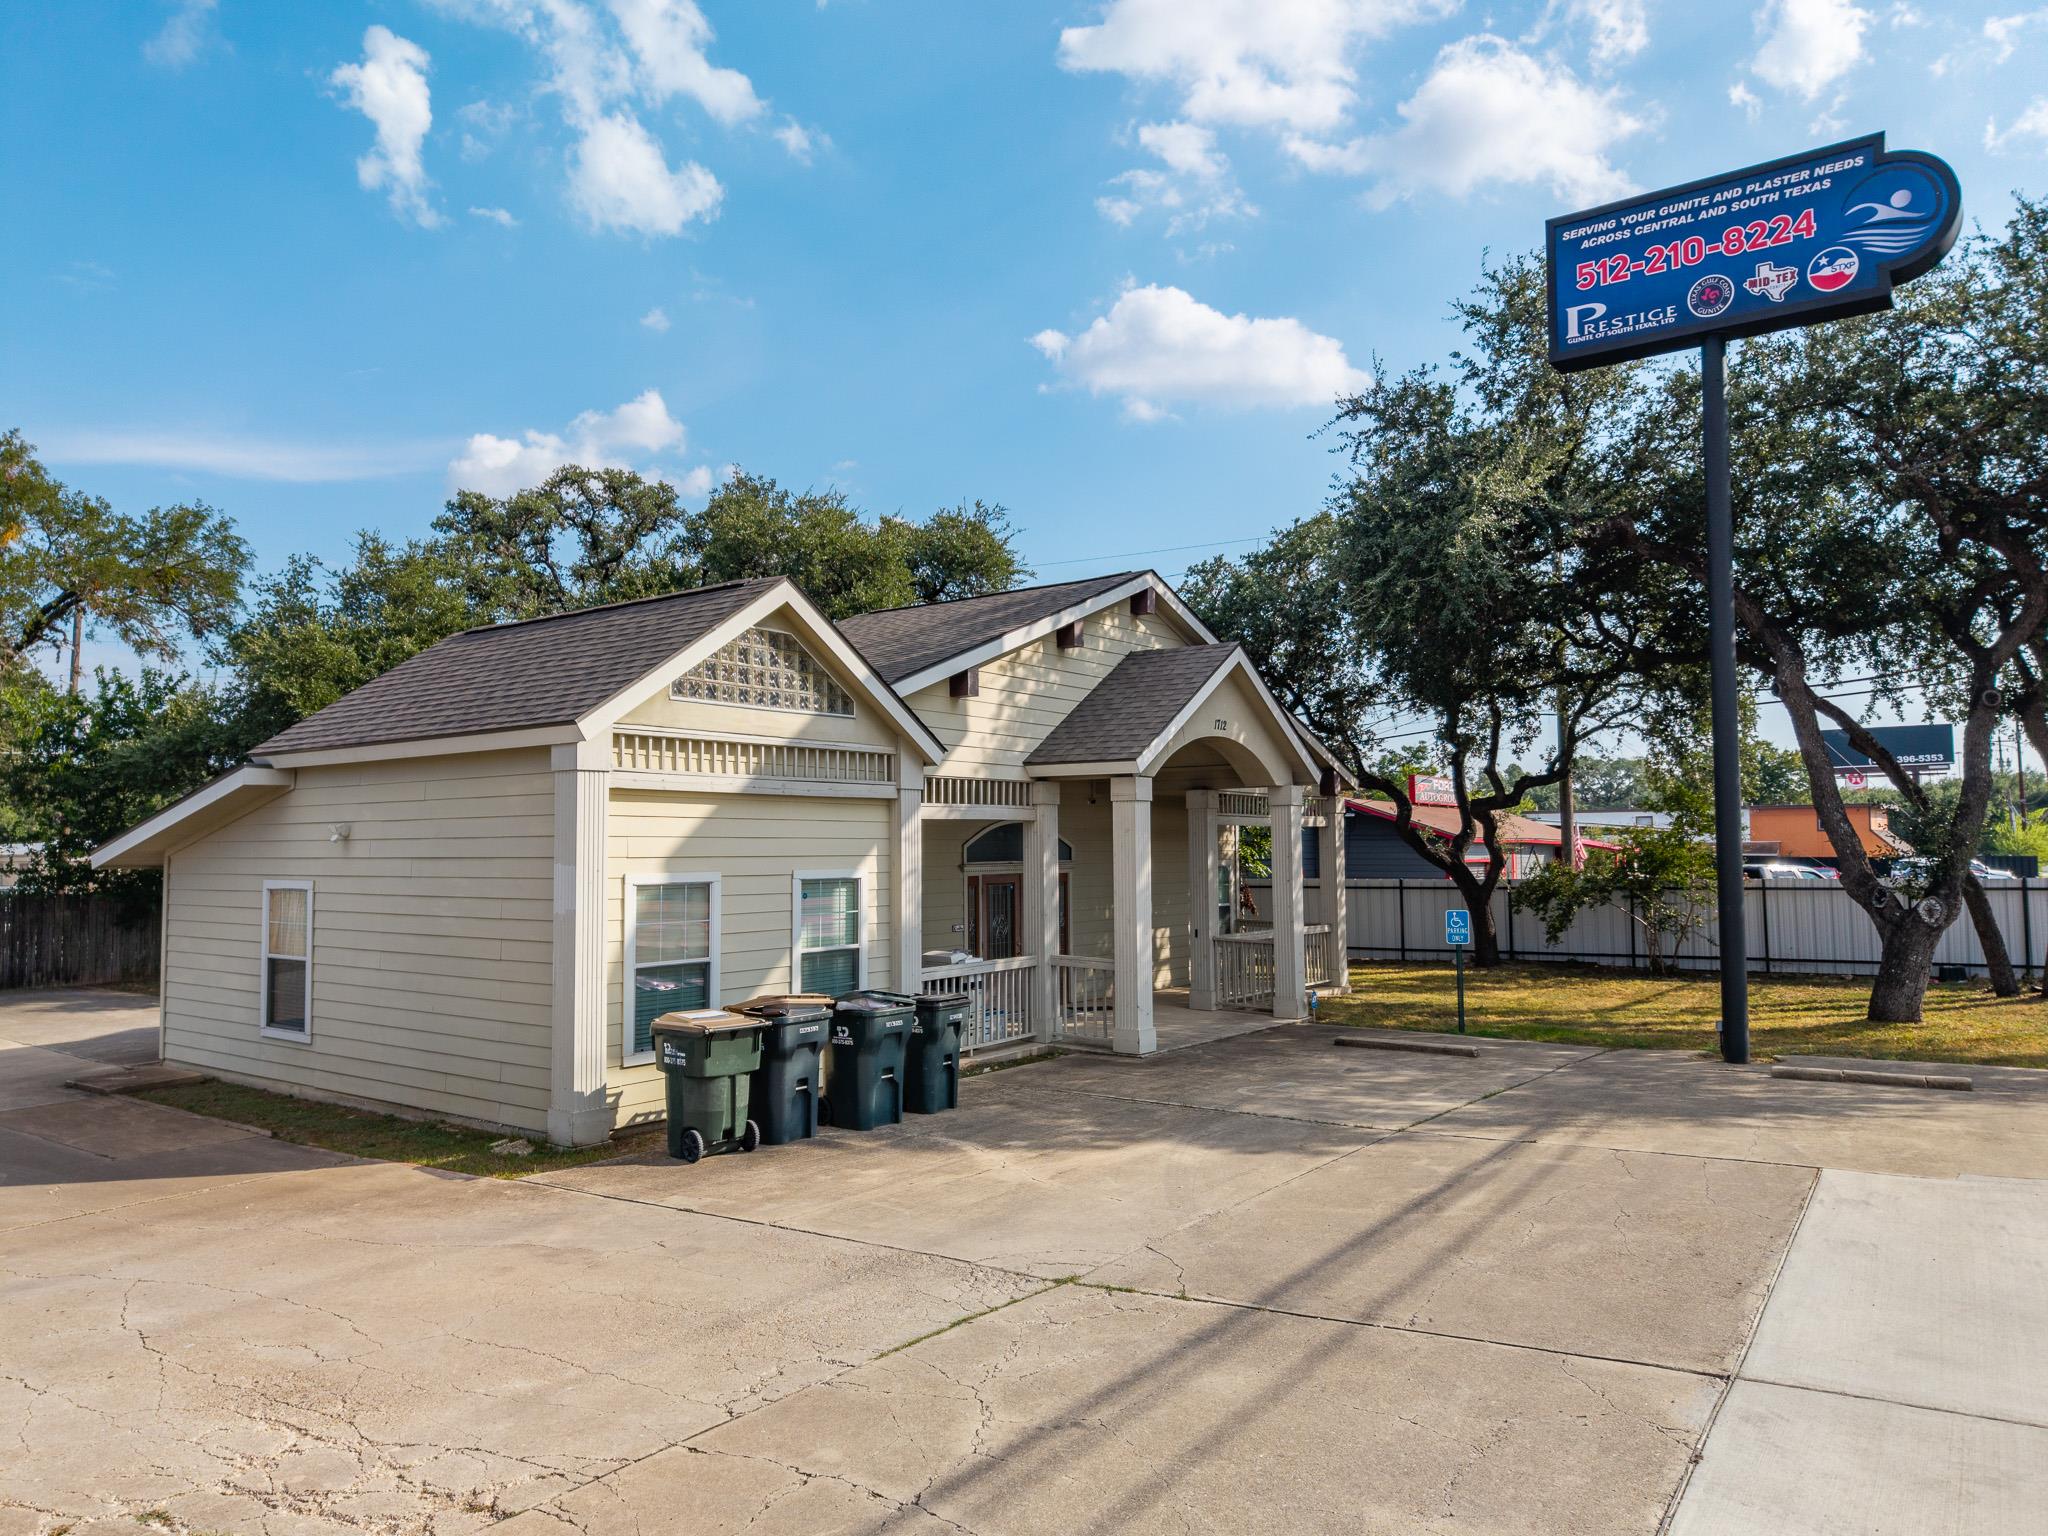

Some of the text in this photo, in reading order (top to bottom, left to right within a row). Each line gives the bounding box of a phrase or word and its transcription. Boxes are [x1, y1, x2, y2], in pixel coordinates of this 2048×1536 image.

[1562, 155, 1864, 241] SERVING YOUR GUNITE AND PLASTER NEEDS
[1580, 178, 1832, 250] ACROSS CENTRAL AND SOUTH TEXAS
[1576, 208, 1817, 291] 512-210-8224
[1830, 261, 1856, 273] STXP
[1748, 270, 1797, 289] MID-TEX
[1691, 277, 1731, 305] TEXAS GULF COAST
[1697, 304, 1725, 315] GUNITE
[1567, 317, 1675, 344] GUNITE OF SOUTH TEXAS, LTD
[1214, 719, 1227, 731] 1712
[1896, 753, 1945, 764] 396-5353
[1420, 791, 1456, 802] AUTOGROU
